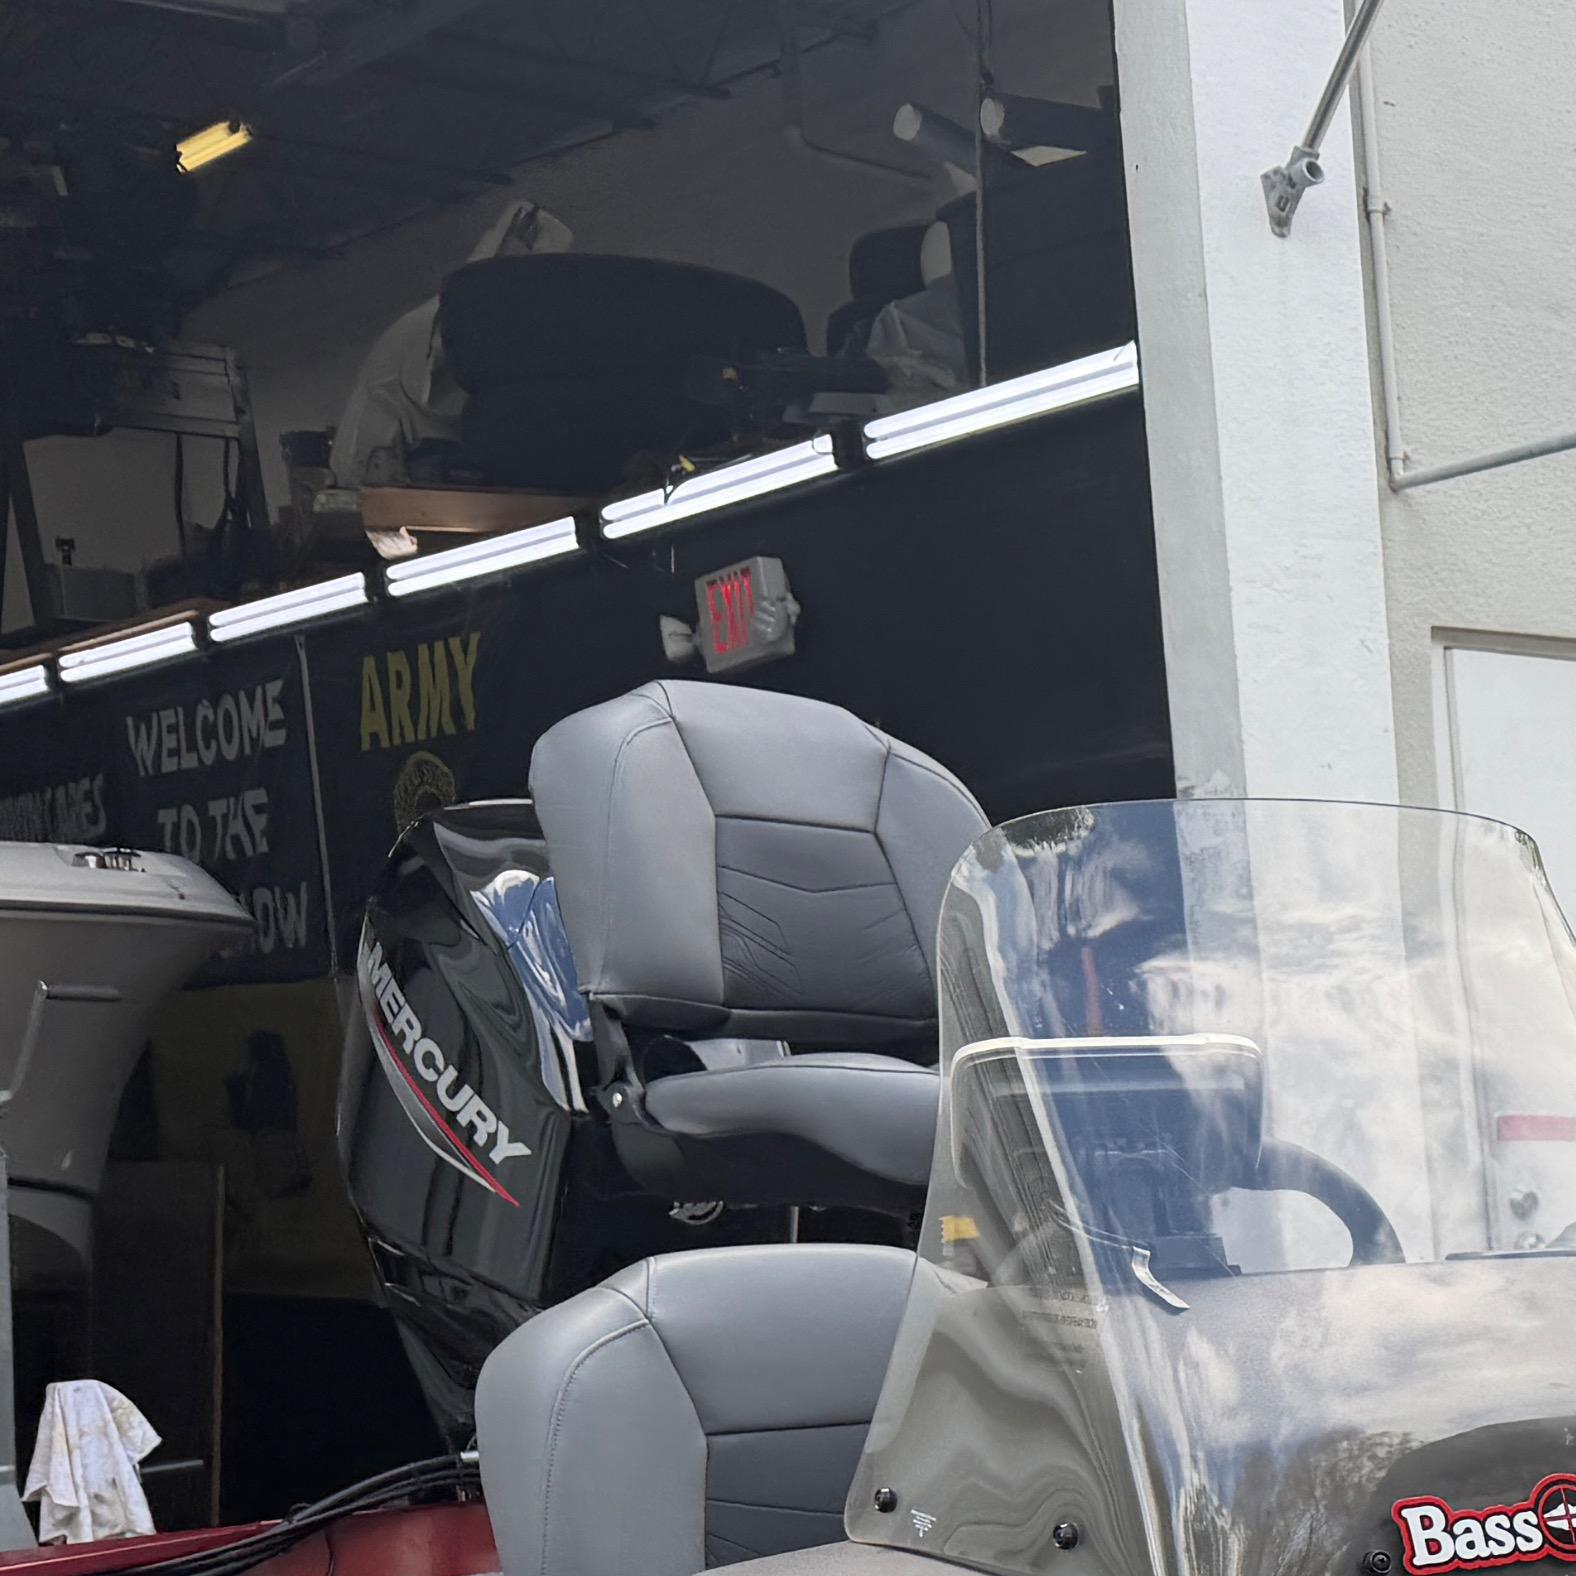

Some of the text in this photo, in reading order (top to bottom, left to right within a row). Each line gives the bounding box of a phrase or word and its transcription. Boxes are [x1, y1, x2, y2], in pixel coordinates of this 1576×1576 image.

[706, 573, 755, 656] EXIT
[126, 680, 287, 776] WELCOME
[360, 632, 481, 751] ARMY
[157, 804, 201, 864] TO
[208, 788, 270, 861] THE
[245, 881, 308, 954] OW
[366, 941, 532, 1165] MERCURY
[1401, 1505, 1544, 1567] Bass
